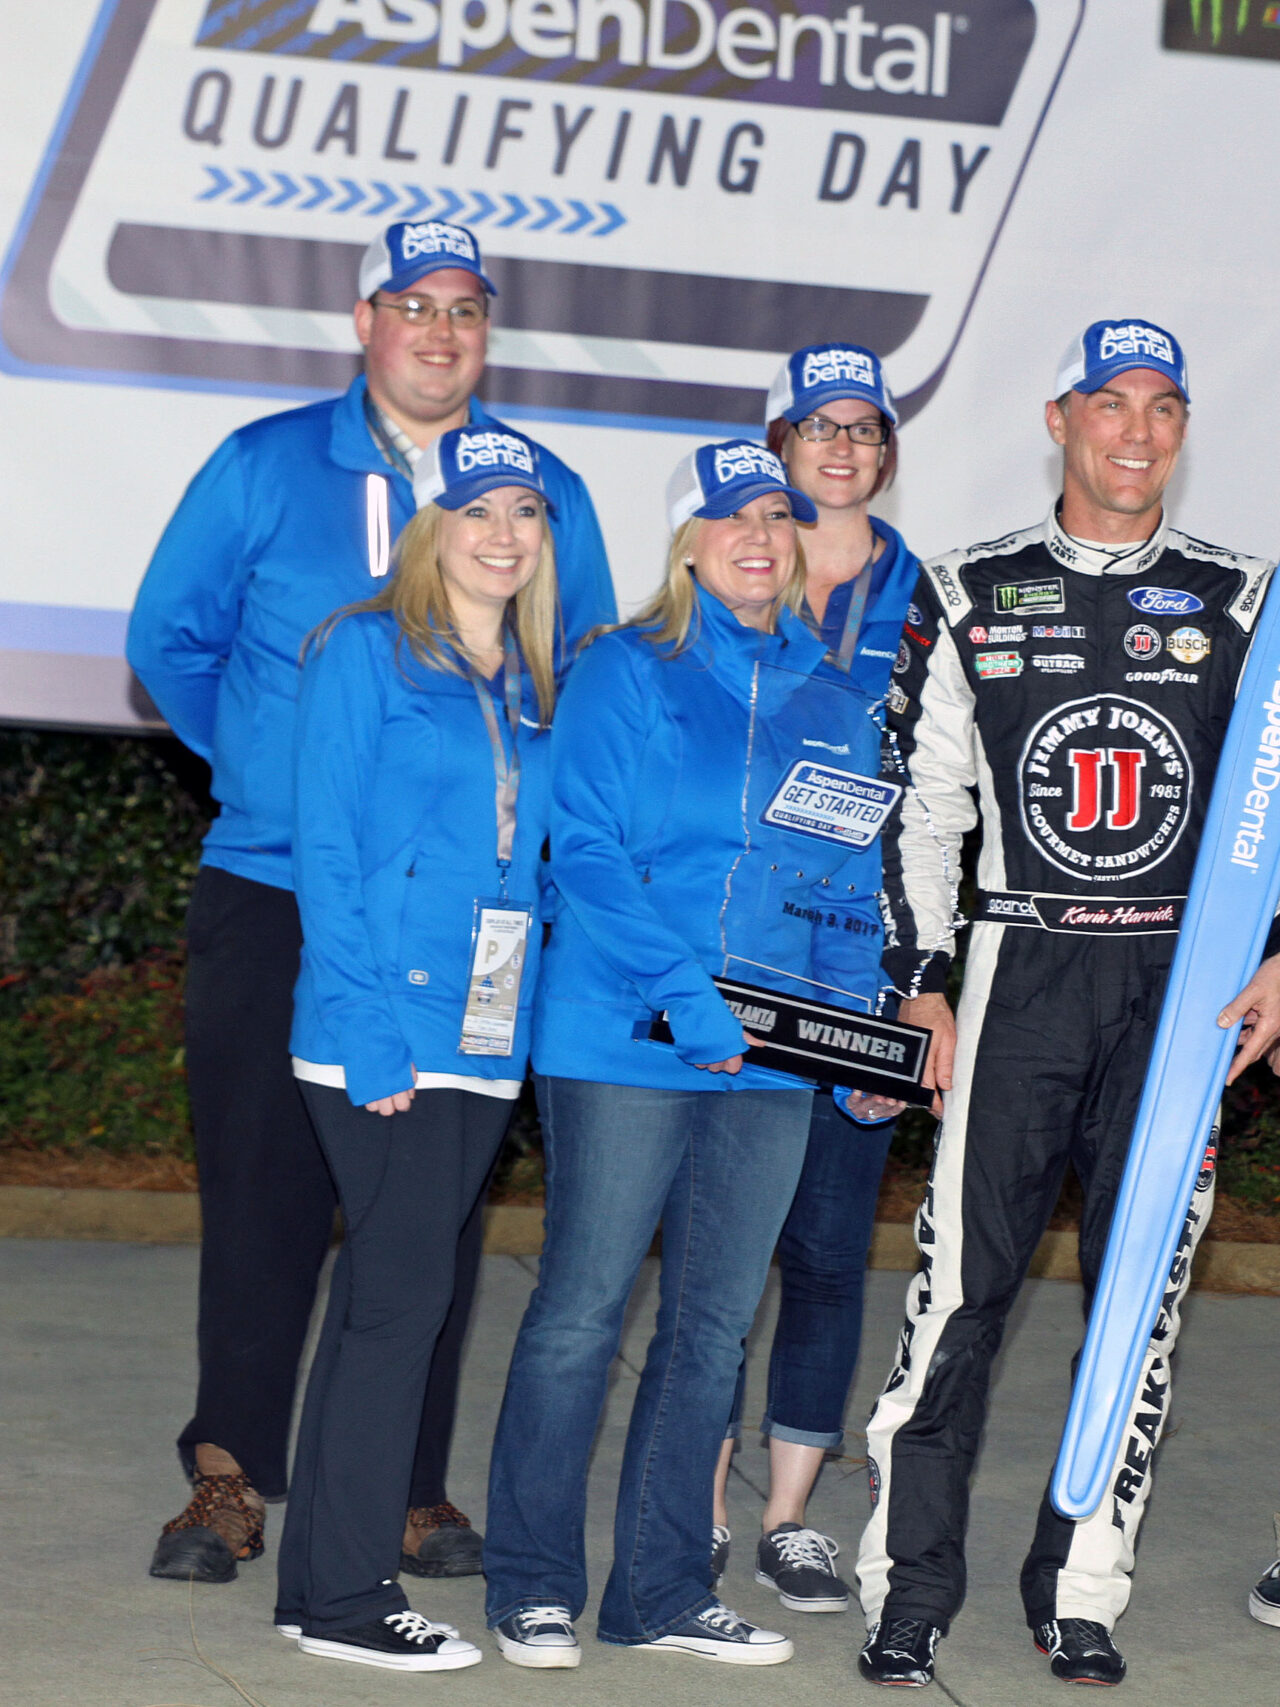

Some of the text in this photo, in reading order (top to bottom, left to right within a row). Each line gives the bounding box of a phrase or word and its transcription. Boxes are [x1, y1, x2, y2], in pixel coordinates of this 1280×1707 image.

[307, 0, 950, 98] AspenDental
[183, 69, 991, 215] QUALIFYING DAY
[402, 221, 473, 248] Aspen
[402, 237, 476, 262] Dental
[1100, 325, 1171, 350] Aspen
[803, 349, 873, 371] Aspen
[1101, 340, 1175, 365] Dental
[804, 365, 875, 388] Dental
[457, 432, 529, 455] Aspen
[457, 449, 534, 474] Dental
[715, 445, 783, 468] Aspen
[716, 459, 787, 485] Dental
[1140, 588, 1191, 612] Ford
[1167, 638, 1210, 651] BUSCH
[1032, 658, 1085, 669] OUTBACK
[1027, 706, 1184, 778] JIMMY JOHN'S
[806, 769, 886, 801] AspenDental
[1028, 783, 1063, 798] Since
[1066, 748, 1147, 832] JJ
[1150, 784, 1182, 800] 1983
[783, 785, 884, 823] GET STARTED
[1029, 803, 1181, 868] GOURMET SANDWICHES
[782, 901, 823, 924] March
[844, 917, 881, 937] 2017
[1061, 904, 1173, 924] Kevin Harvick
[484, 939, 499, 965] P
[798, 1018, 905, 1063] WINNER
